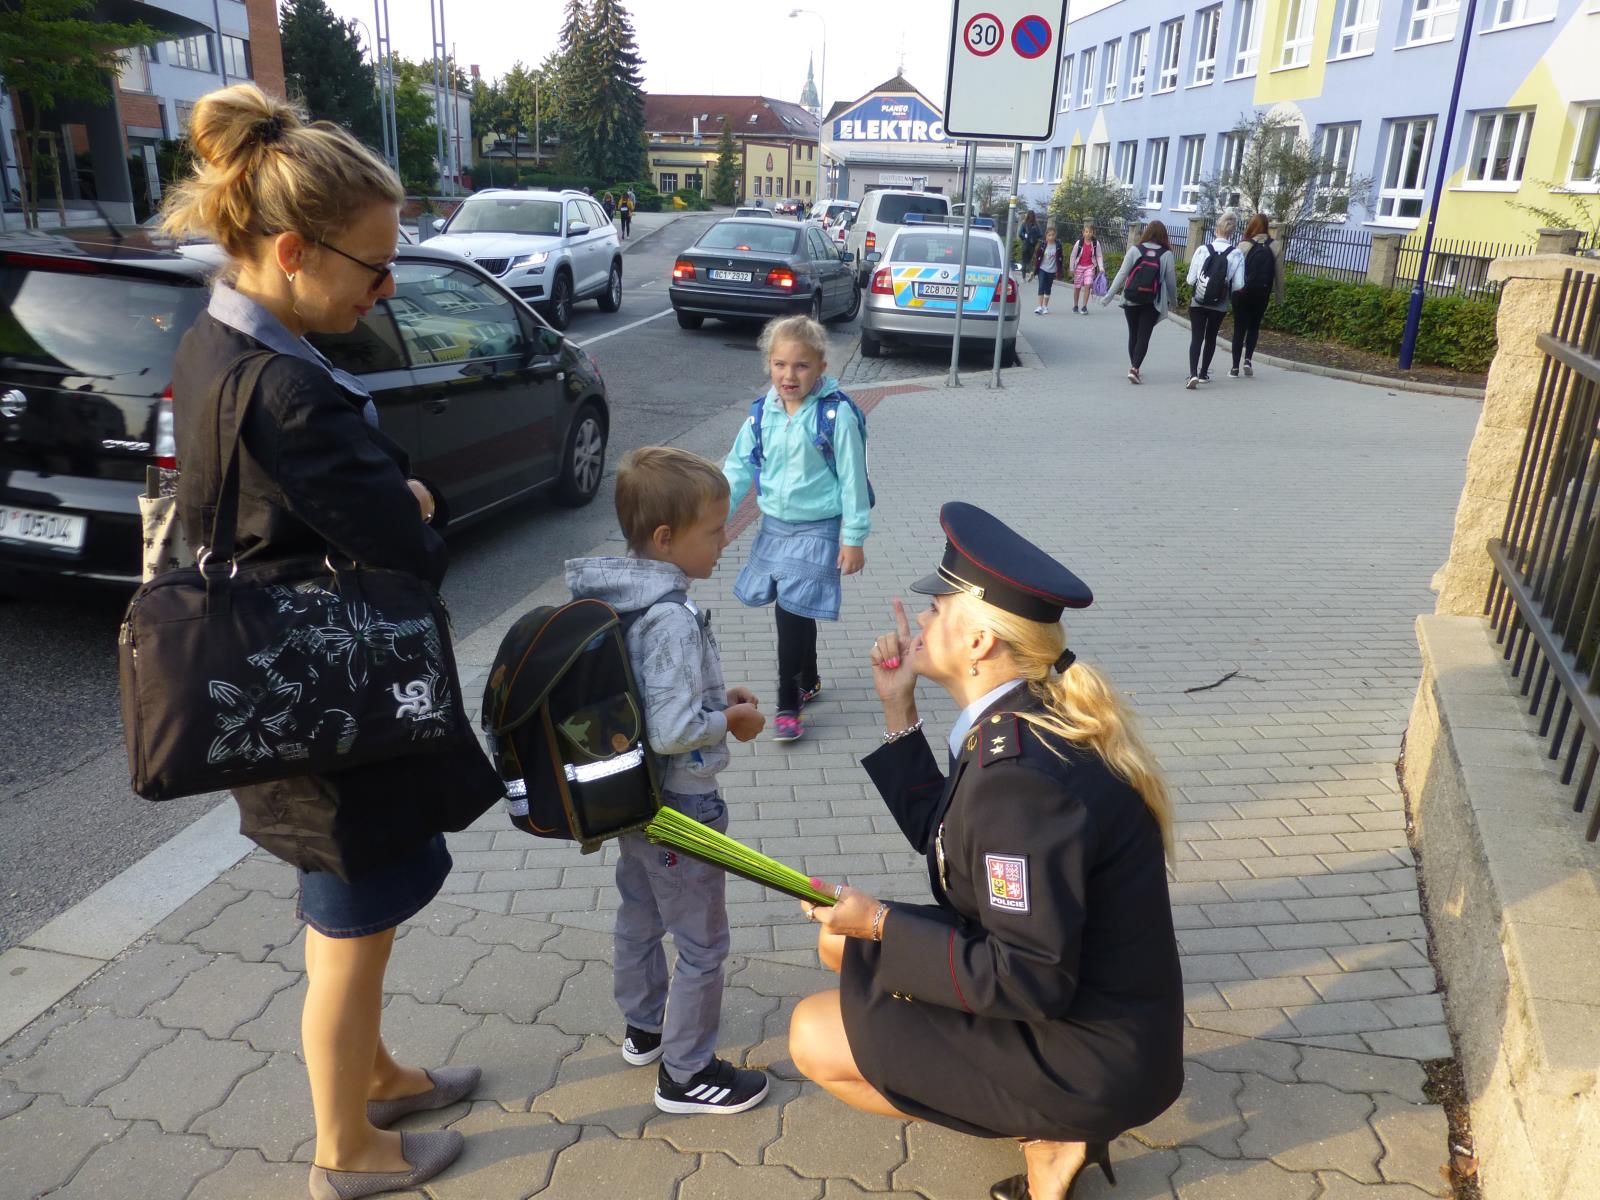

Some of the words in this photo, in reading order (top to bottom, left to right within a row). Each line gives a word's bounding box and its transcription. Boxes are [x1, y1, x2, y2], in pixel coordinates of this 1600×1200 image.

[971, 24, 997, 46] 30
[881, 104, 909, 113] PLANEO
[840, 119, 945, 142] ELEKTRO
[966, 273, 994, 283] OLICIE
[925, 285, 940, 294] 2C8
[992, 896, 1025, 908] POLICIE
